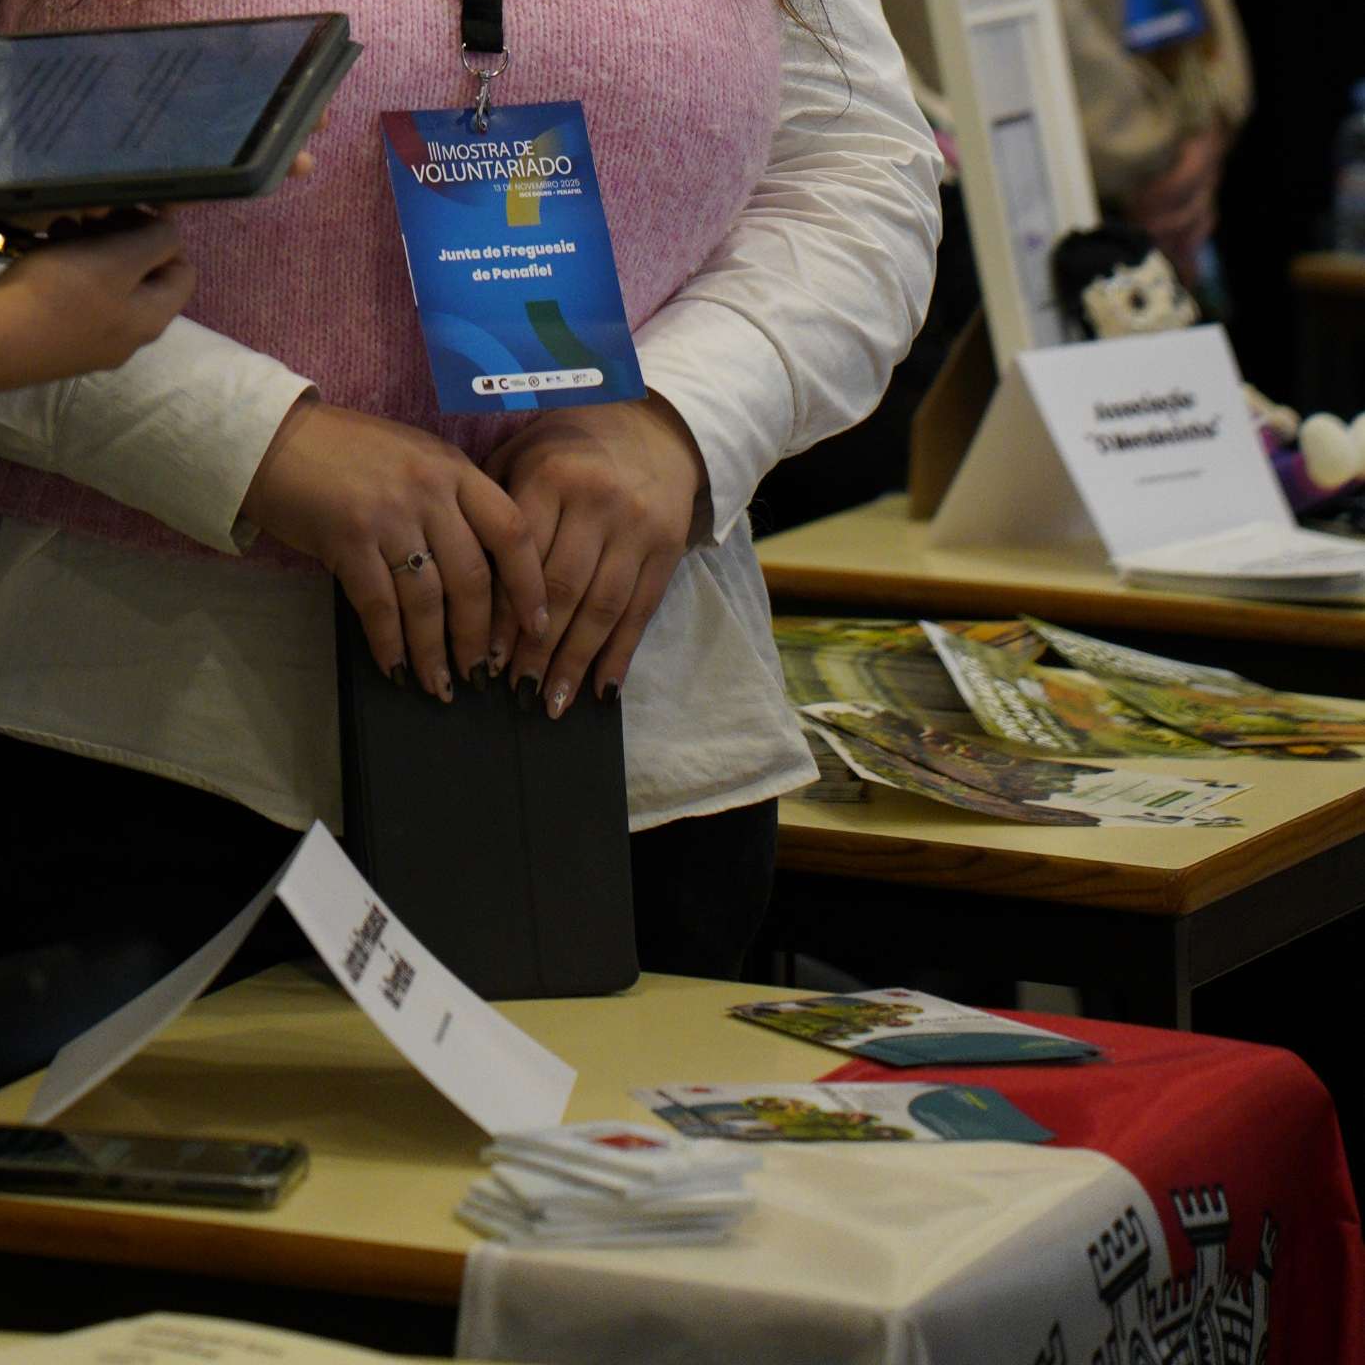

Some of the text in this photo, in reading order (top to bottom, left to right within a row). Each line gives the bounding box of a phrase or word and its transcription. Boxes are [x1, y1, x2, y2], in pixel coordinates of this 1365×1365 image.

[442, 142, 511, 161] MOSTRA
[514, 140, 535, 157] DE
[411, 156, 573, 184] VOLUNTARIADO
[502, 182, 512, 192] DE
[514, 180, 559, 192] NOVEMBRO
[438, 239, 576, 262] Junta de Freguesia
[472, 263, 553, 282] de Penafiel
